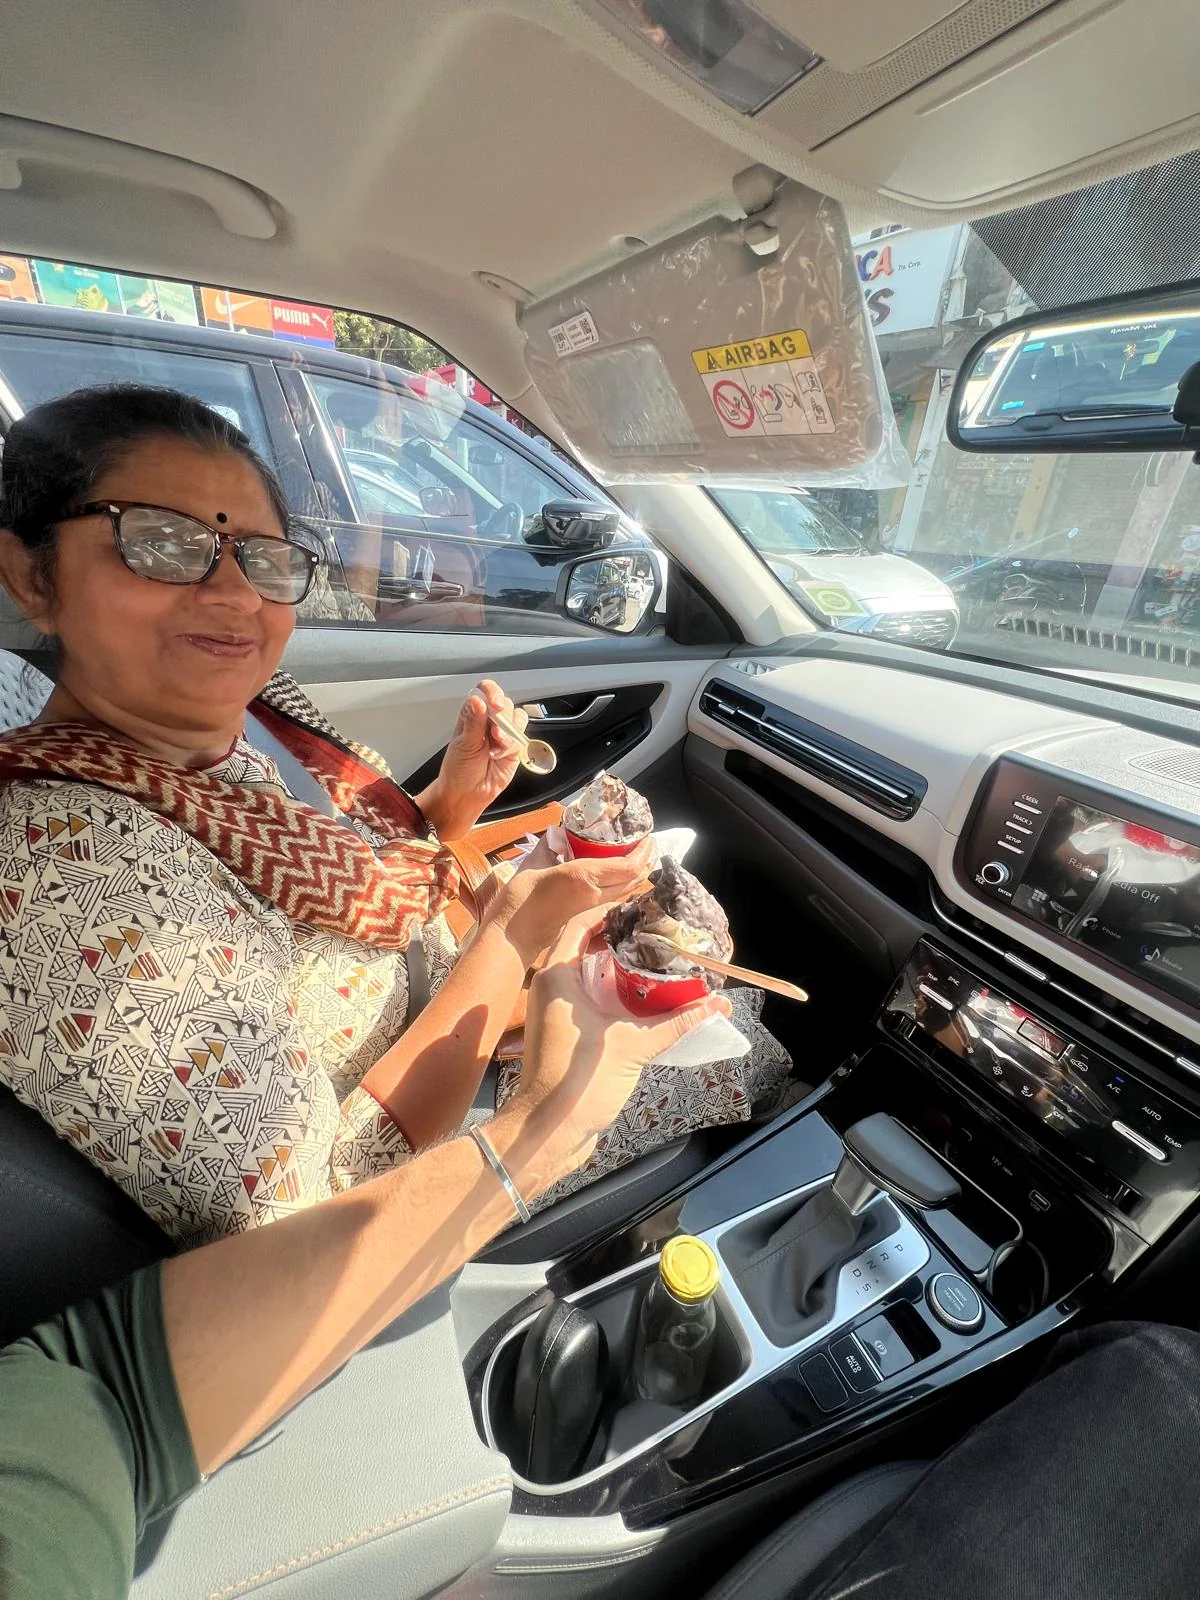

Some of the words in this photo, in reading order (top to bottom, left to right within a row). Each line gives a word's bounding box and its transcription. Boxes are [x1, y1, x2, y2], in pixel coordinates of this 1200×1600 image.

[273, 307, 310, 326] PUMA
[724, 336, 796, 366] AIRBAG
[1025, 795, 1039, 804] SEEK
[1012, 813, 1029, 825] TRACK
[1005, 834, 1021, 844] SETUP
[997, 887, 1012, 897] ENTER
[1141, 889, 1160, 903] Off
[1107, 1083, 1121, 1094] A/C
[1141, 1106, 1161, 1120] AUTO
[1164, 1135, 1182, 1149] TEMP
[894, 1244, 904, 1252] P
[880, 1252, 890, 1262] R
[866, 1260, 877, 1270] N
[852, 1268, 862, 1278] D
[862, 1283, 872, 1292] S
[845, 1356, 858, 1373] HOLD
[849, 1355, 862, 1372] AUTO
